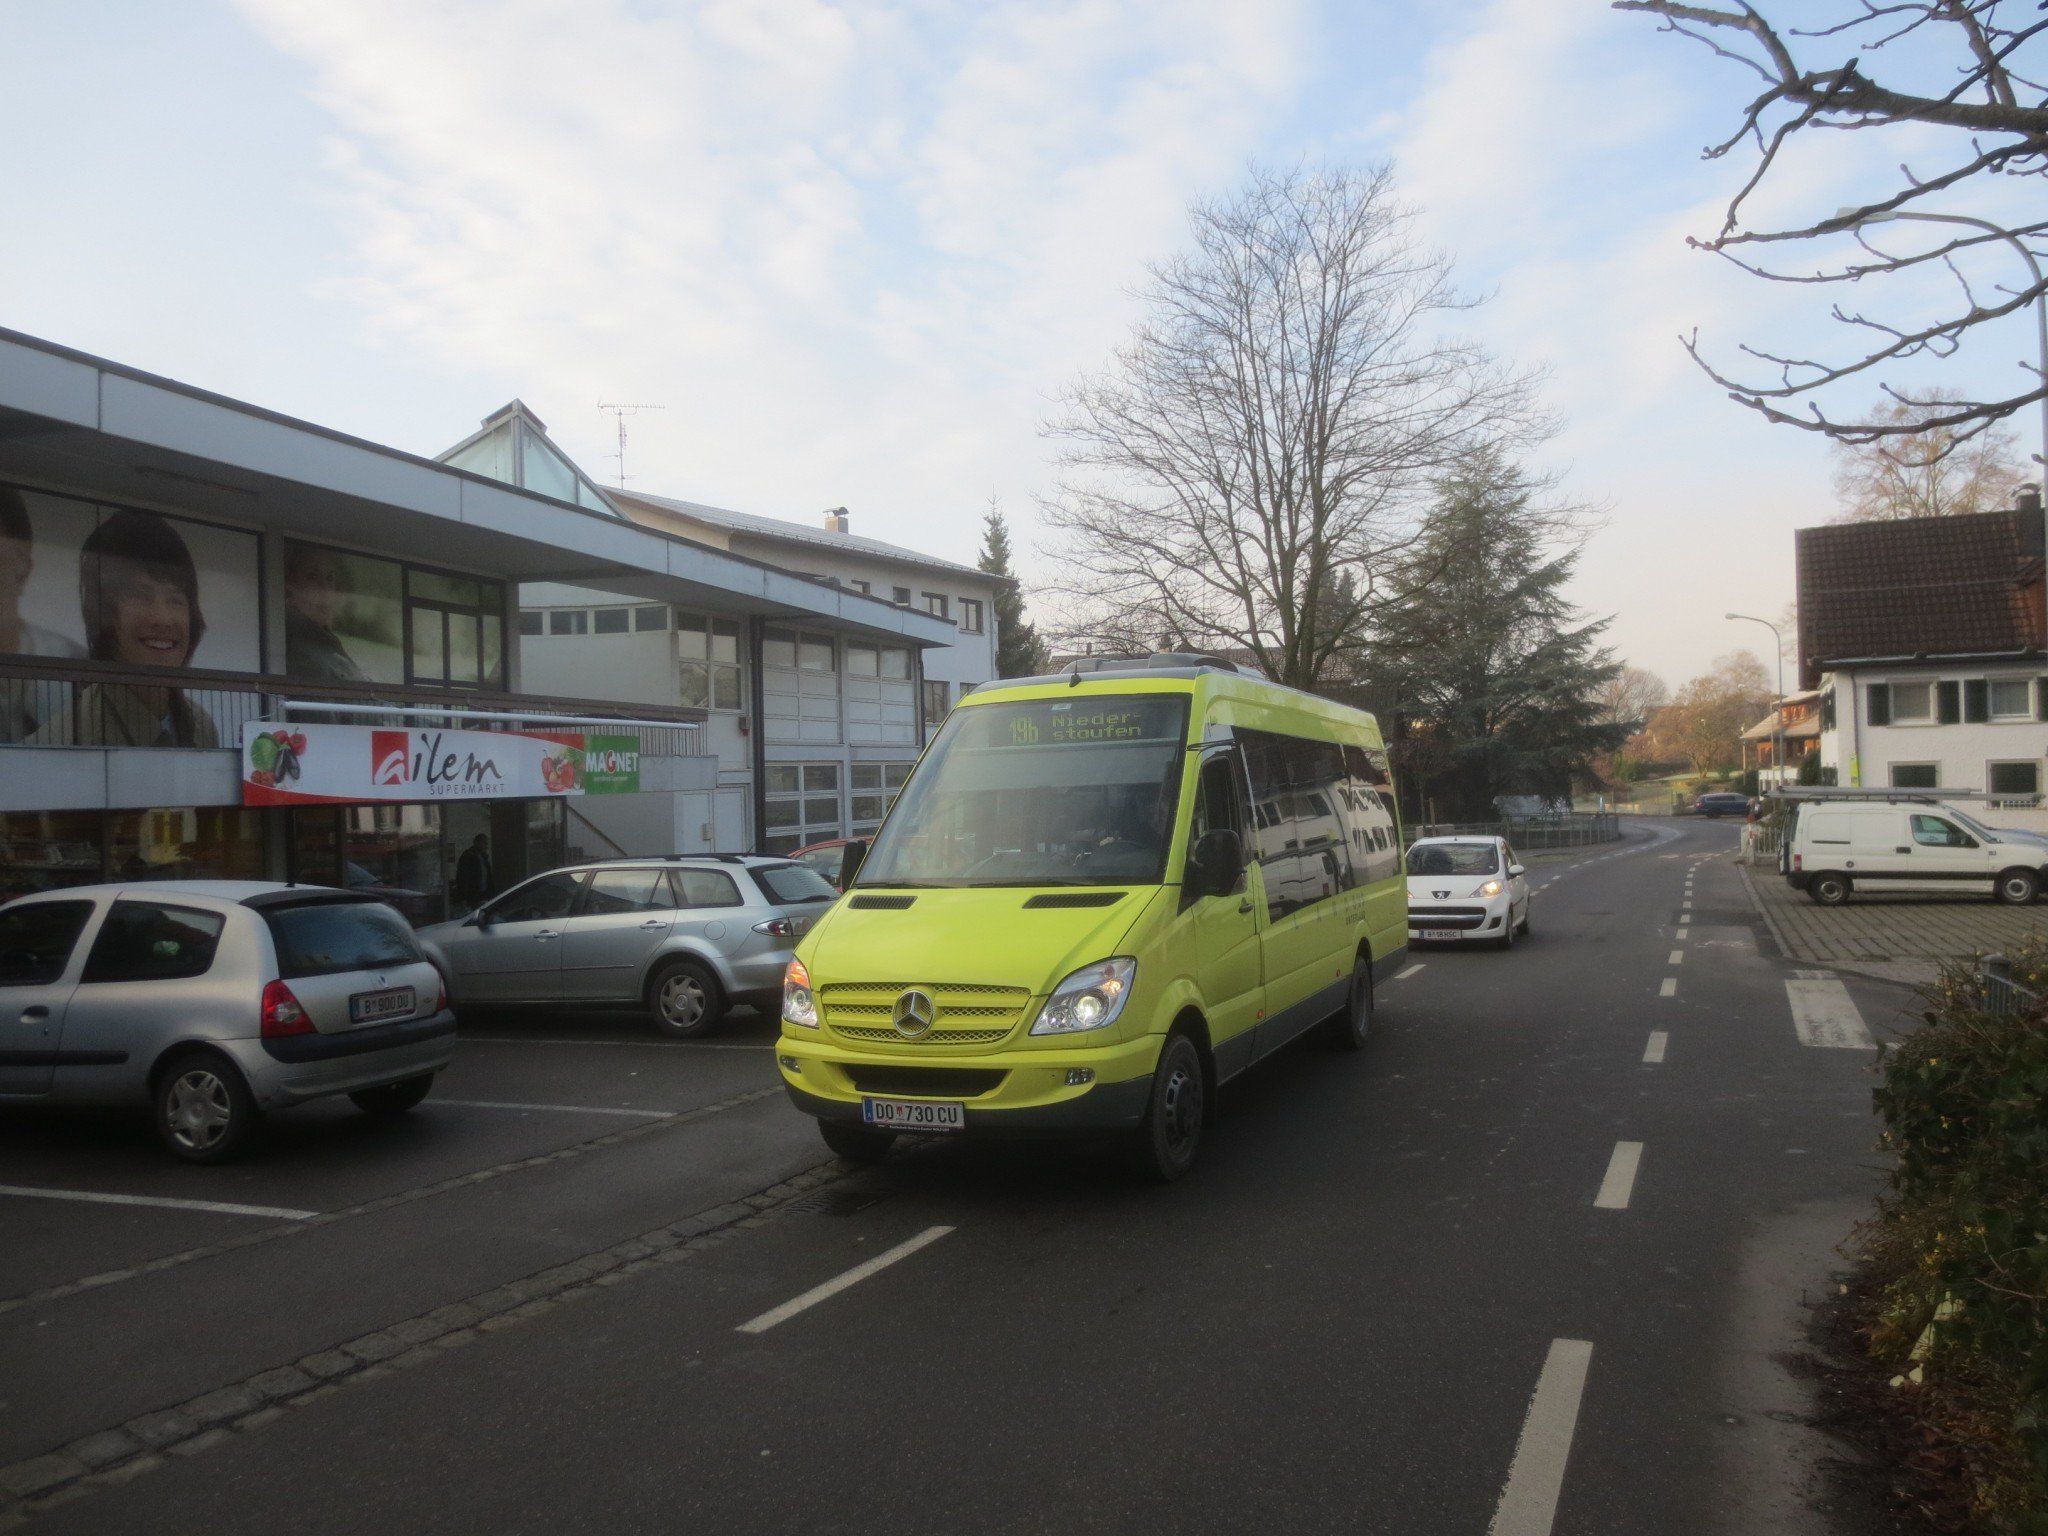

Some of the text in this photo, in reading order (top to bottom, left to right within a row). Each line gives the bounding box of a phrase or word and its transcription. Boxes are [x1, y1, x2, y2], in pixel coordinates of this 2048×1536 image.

[1052, 712, 1141, 727] Nieder-
[1052, 725, 1142, 741] staufen
[586, 750, 638, 773] MAGNET
[430, 783, 505, 795] SUPERMARKT
[365, 1000, 371, 1014] B
[876, 1103, 957, 1123] DO 730 CU
